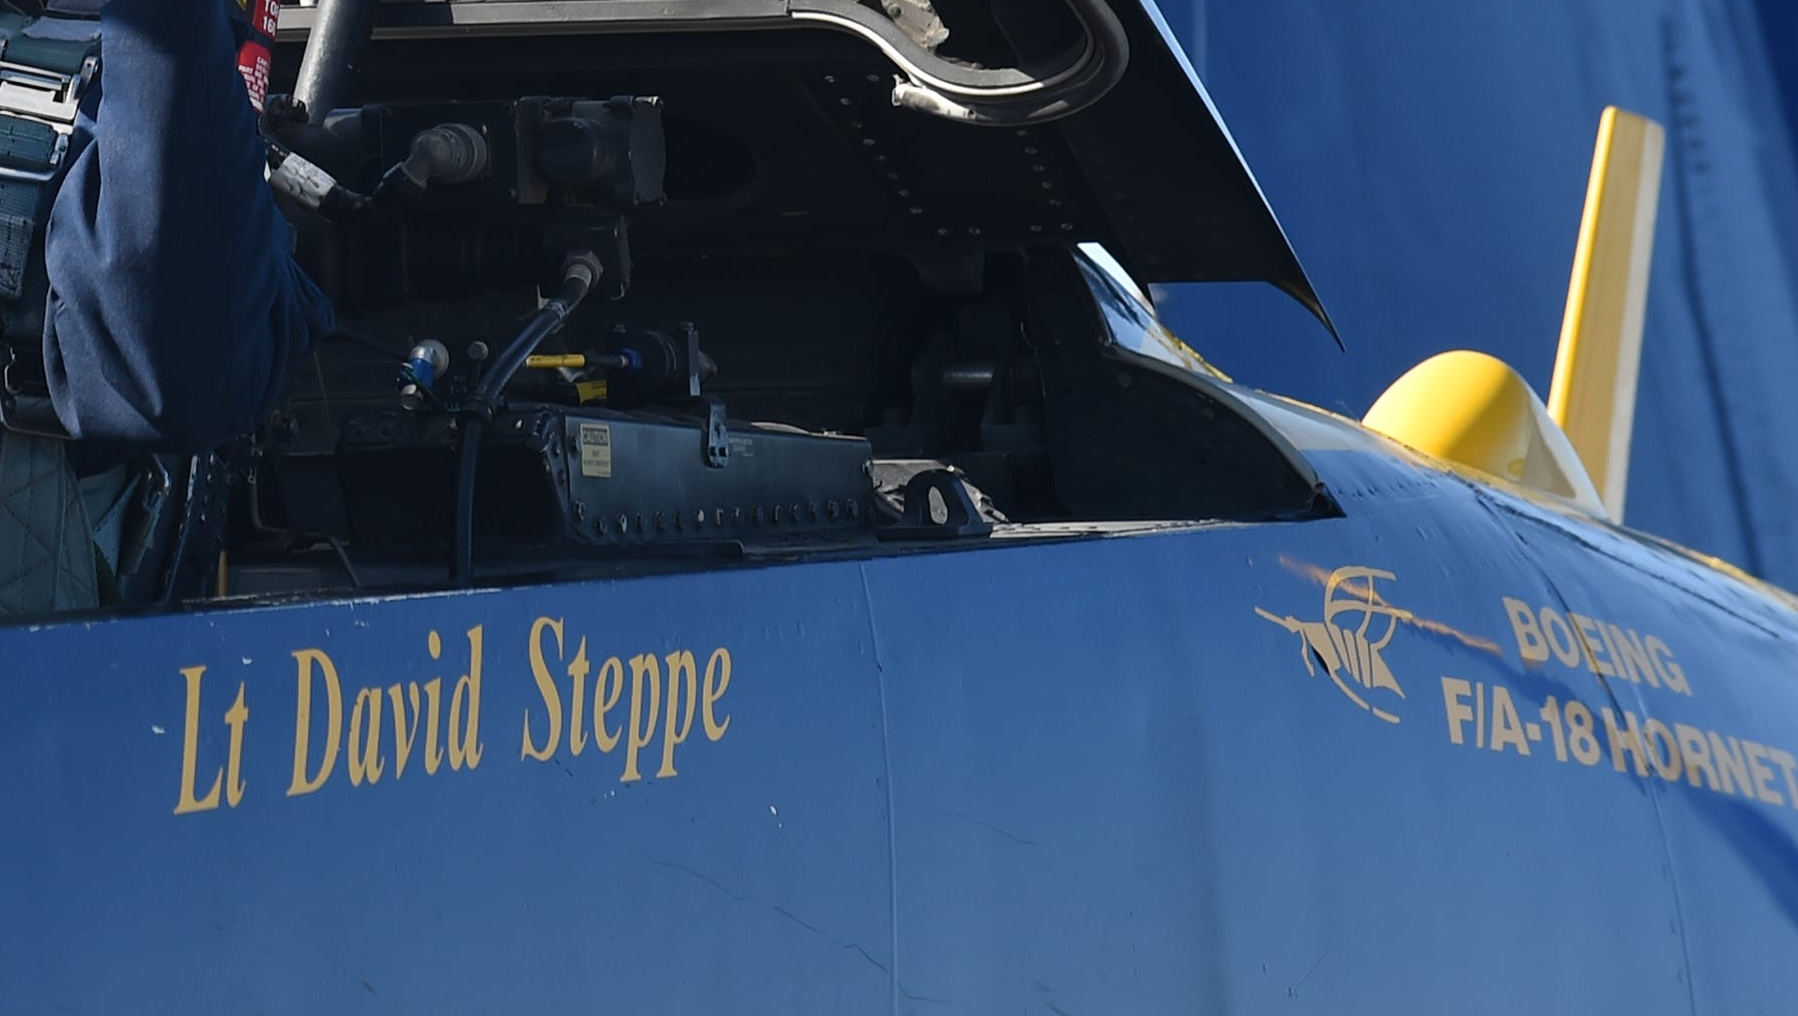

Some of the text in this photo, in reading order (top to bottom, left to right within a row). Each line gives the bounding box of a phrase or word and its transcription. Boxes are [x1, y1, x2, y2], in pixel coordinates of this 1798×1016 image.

[1502, 596, 1692, 696] BOEING
[174, 616, 733, 815] Lt David Steppe
[1441, 675, 1798, 810] F/A-18 HORNET
